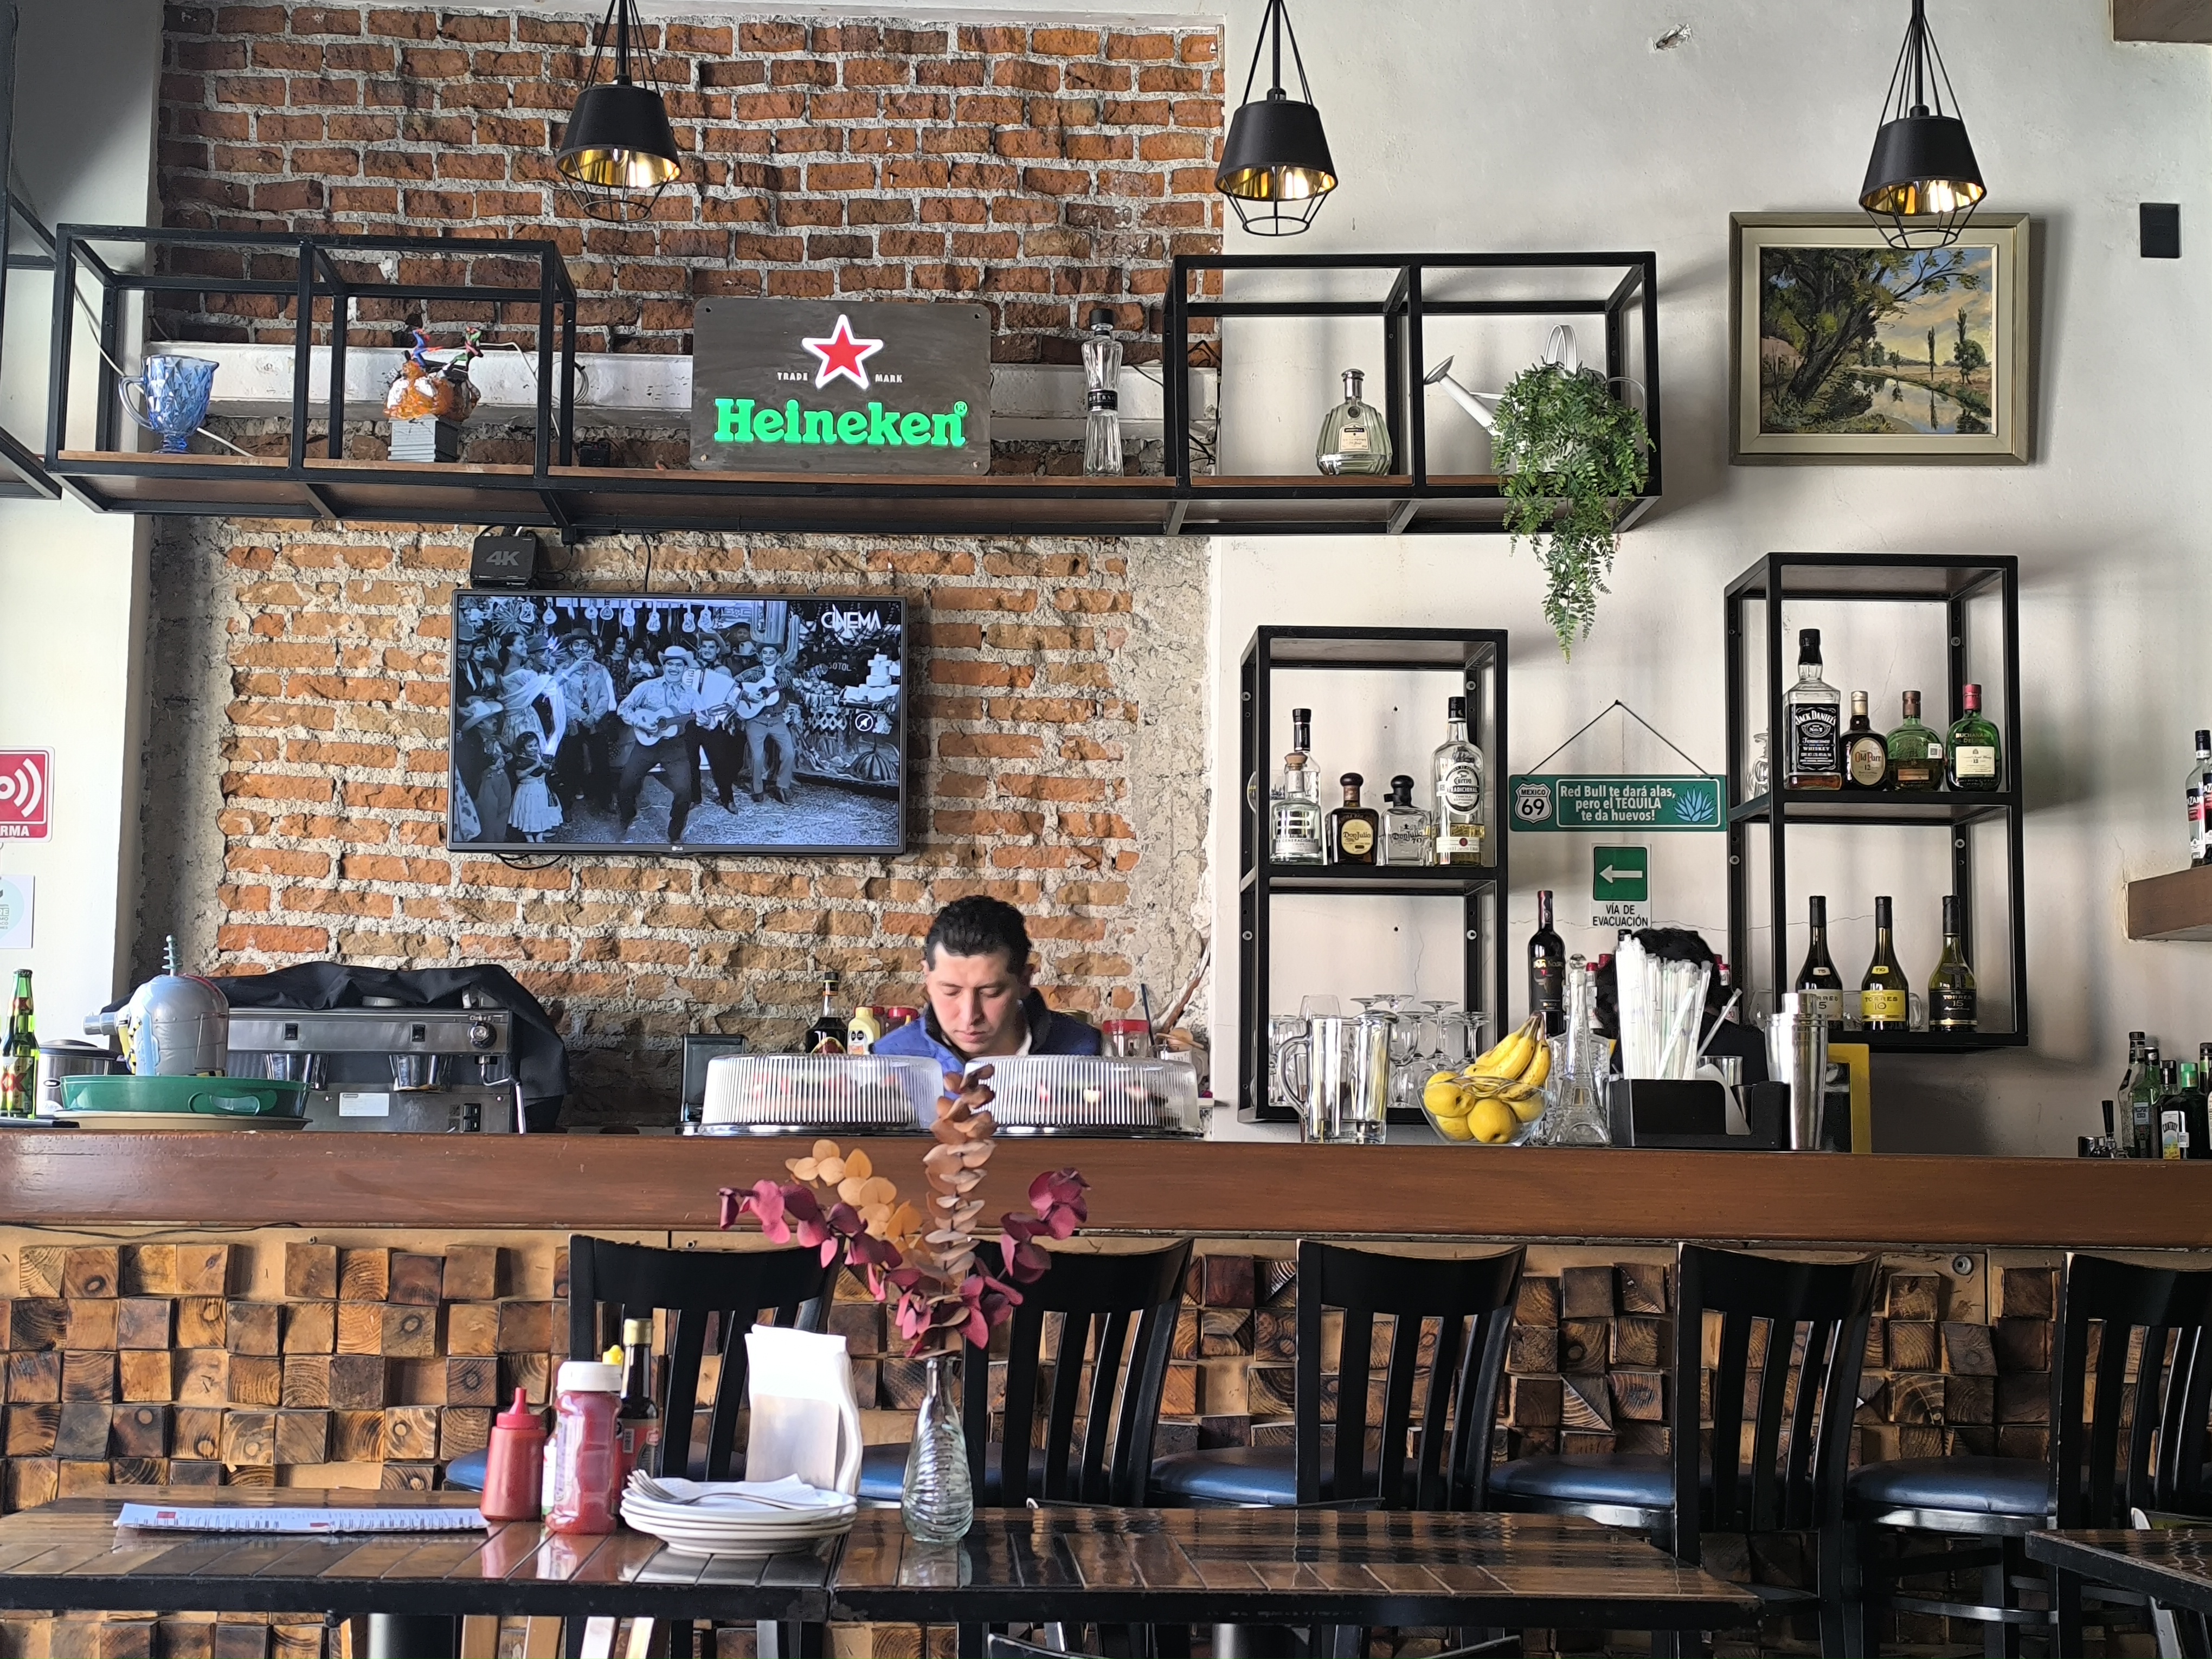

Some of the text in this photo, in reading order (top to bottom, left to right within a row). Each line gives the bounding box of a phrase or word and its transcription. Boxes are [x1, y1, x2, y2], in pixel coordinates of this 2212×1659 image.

[777, 372, 903, 383] TRADE MARK
[486, 551, 520, 565] 4K
[821, 605, 882, 631] CINEMA
[1795, 712, 1812, 725] JACK
[1560, 785, 1676, 799] Red Bull te dará alas,
[1522, 799, 1545, 815] 69
[1576, 797, 1662, 812] pero el TEQUILA
[1581, 809, 1655, 821] te da huevos!
[1606, 902, 1635, 915] VÍA DE
[1593, 914, 1648, 927] EVACUACIÓN
